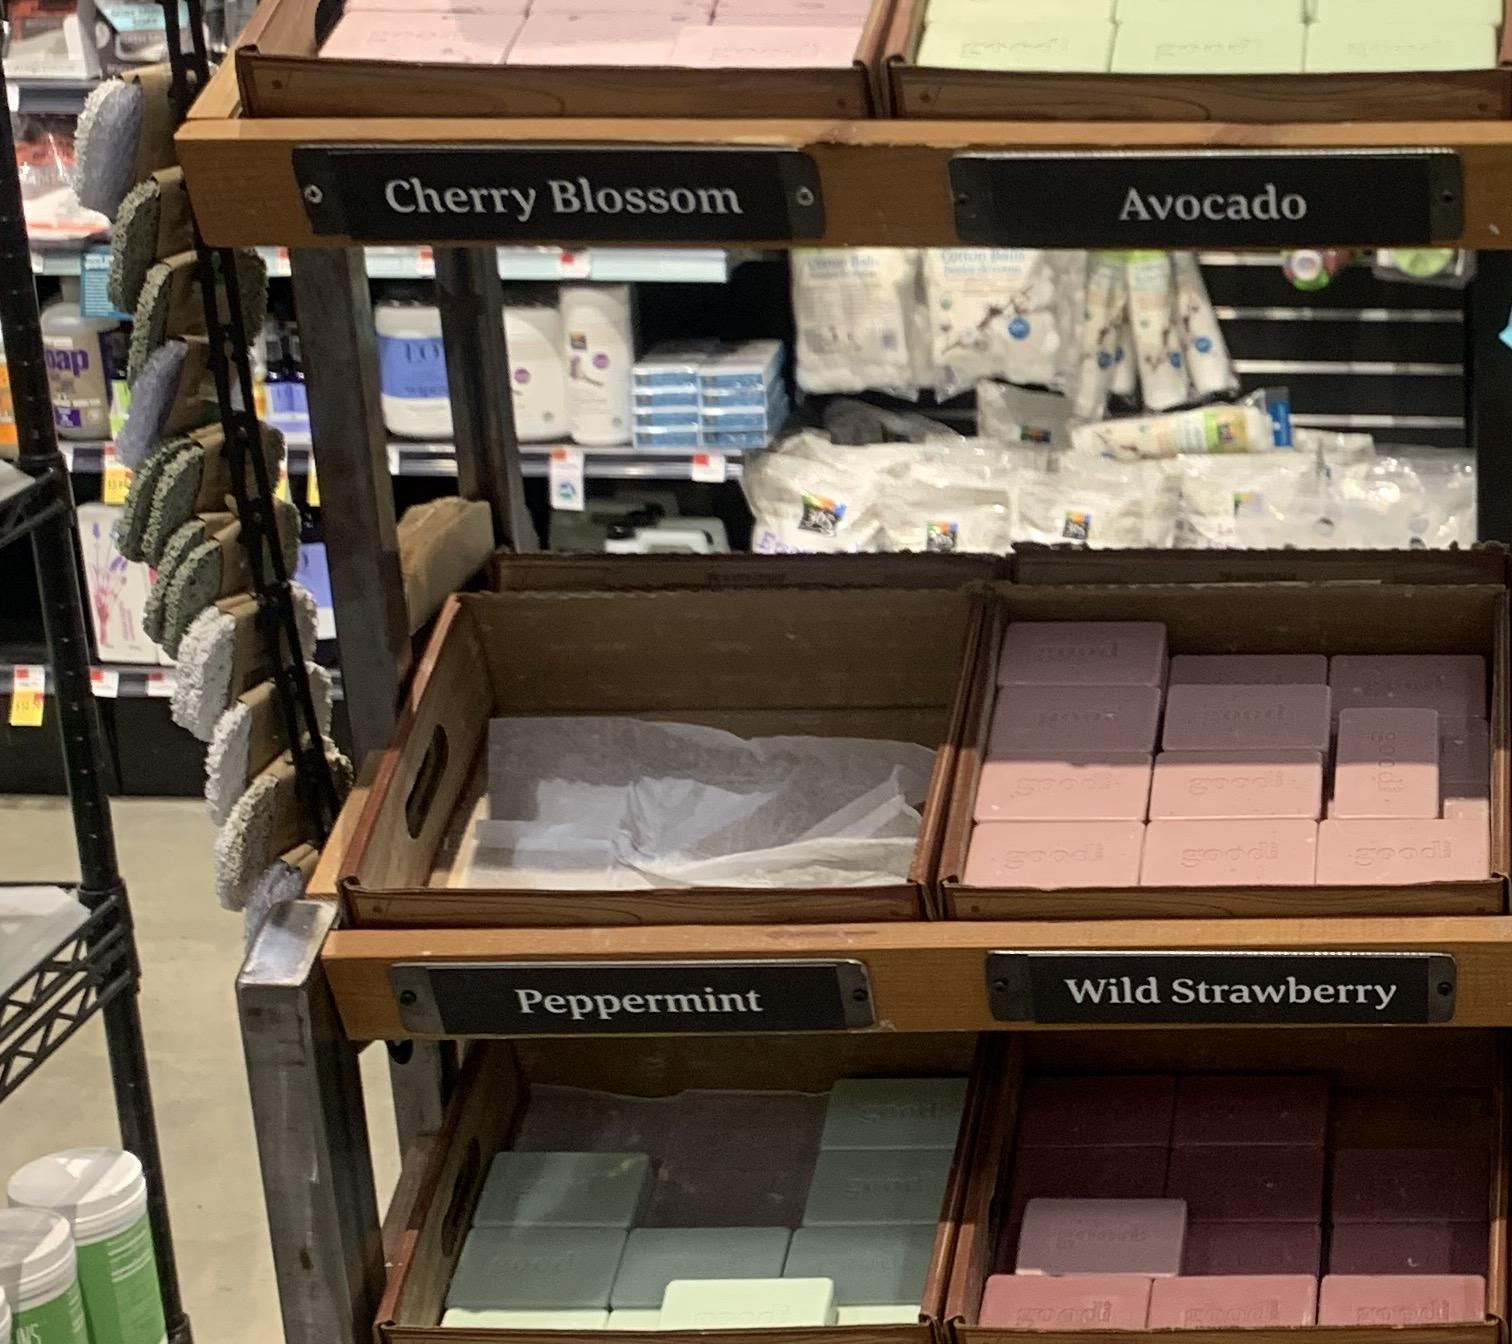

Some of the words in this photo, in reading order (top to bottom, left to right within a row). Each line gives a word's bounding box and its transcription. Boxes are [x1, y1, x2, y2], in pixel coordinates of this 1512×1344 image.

[384, 177, 536, 223] Cherry
[548, 177, 742, 216] Blossom
[1119, 182, 1308, 221] Avocado
[44, 347, 89, 377] oap
[1180, 841, 1276, 869] good
[1353, 840, 1447, 868] good
[513, 986, 763, 1018] Peppermint
[1064, 975, 1160, 1005] Wild
[1171, 975, 1397, 1011] Strawberry
